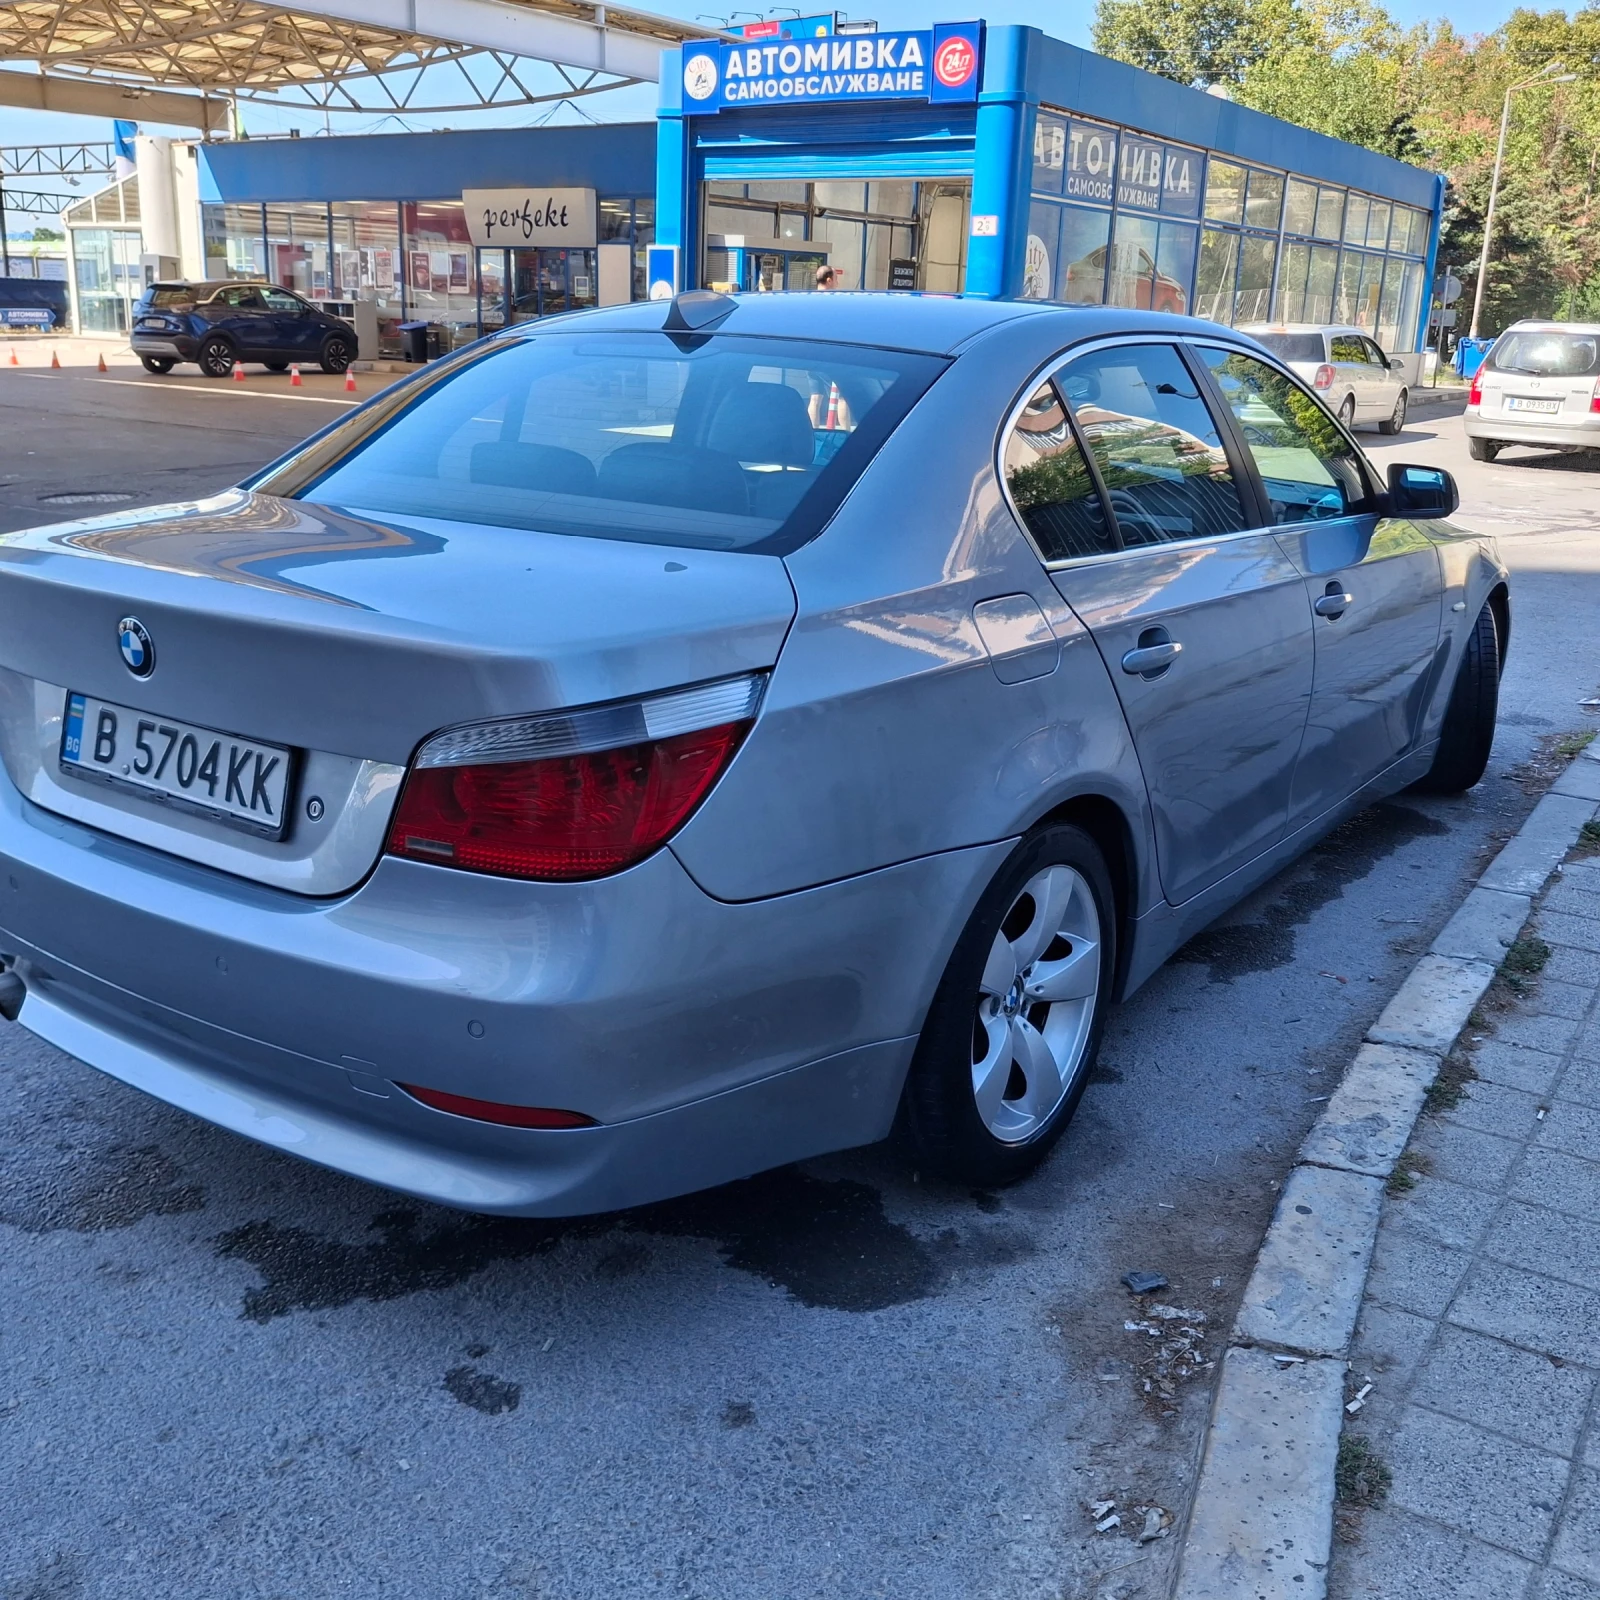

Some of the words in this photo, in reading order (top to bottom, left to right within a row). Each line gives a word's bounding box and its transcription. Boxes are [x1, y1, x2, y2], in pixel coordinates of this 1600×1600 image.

[725, 37, 924, 79] АВТОМИВКА
[725, 71, 923, 101] САМООБСЛУЖВАНЕ
[1034, 122, 1190, 194] АВТОМИВКА
[1067, 177, 1158, 209] САМООБСЛУЖВАНЕ
[483, 197, 569, 239] perfekt
[1027, 239, 1045, 272] ity
[65, 737, 80, 753] BG
